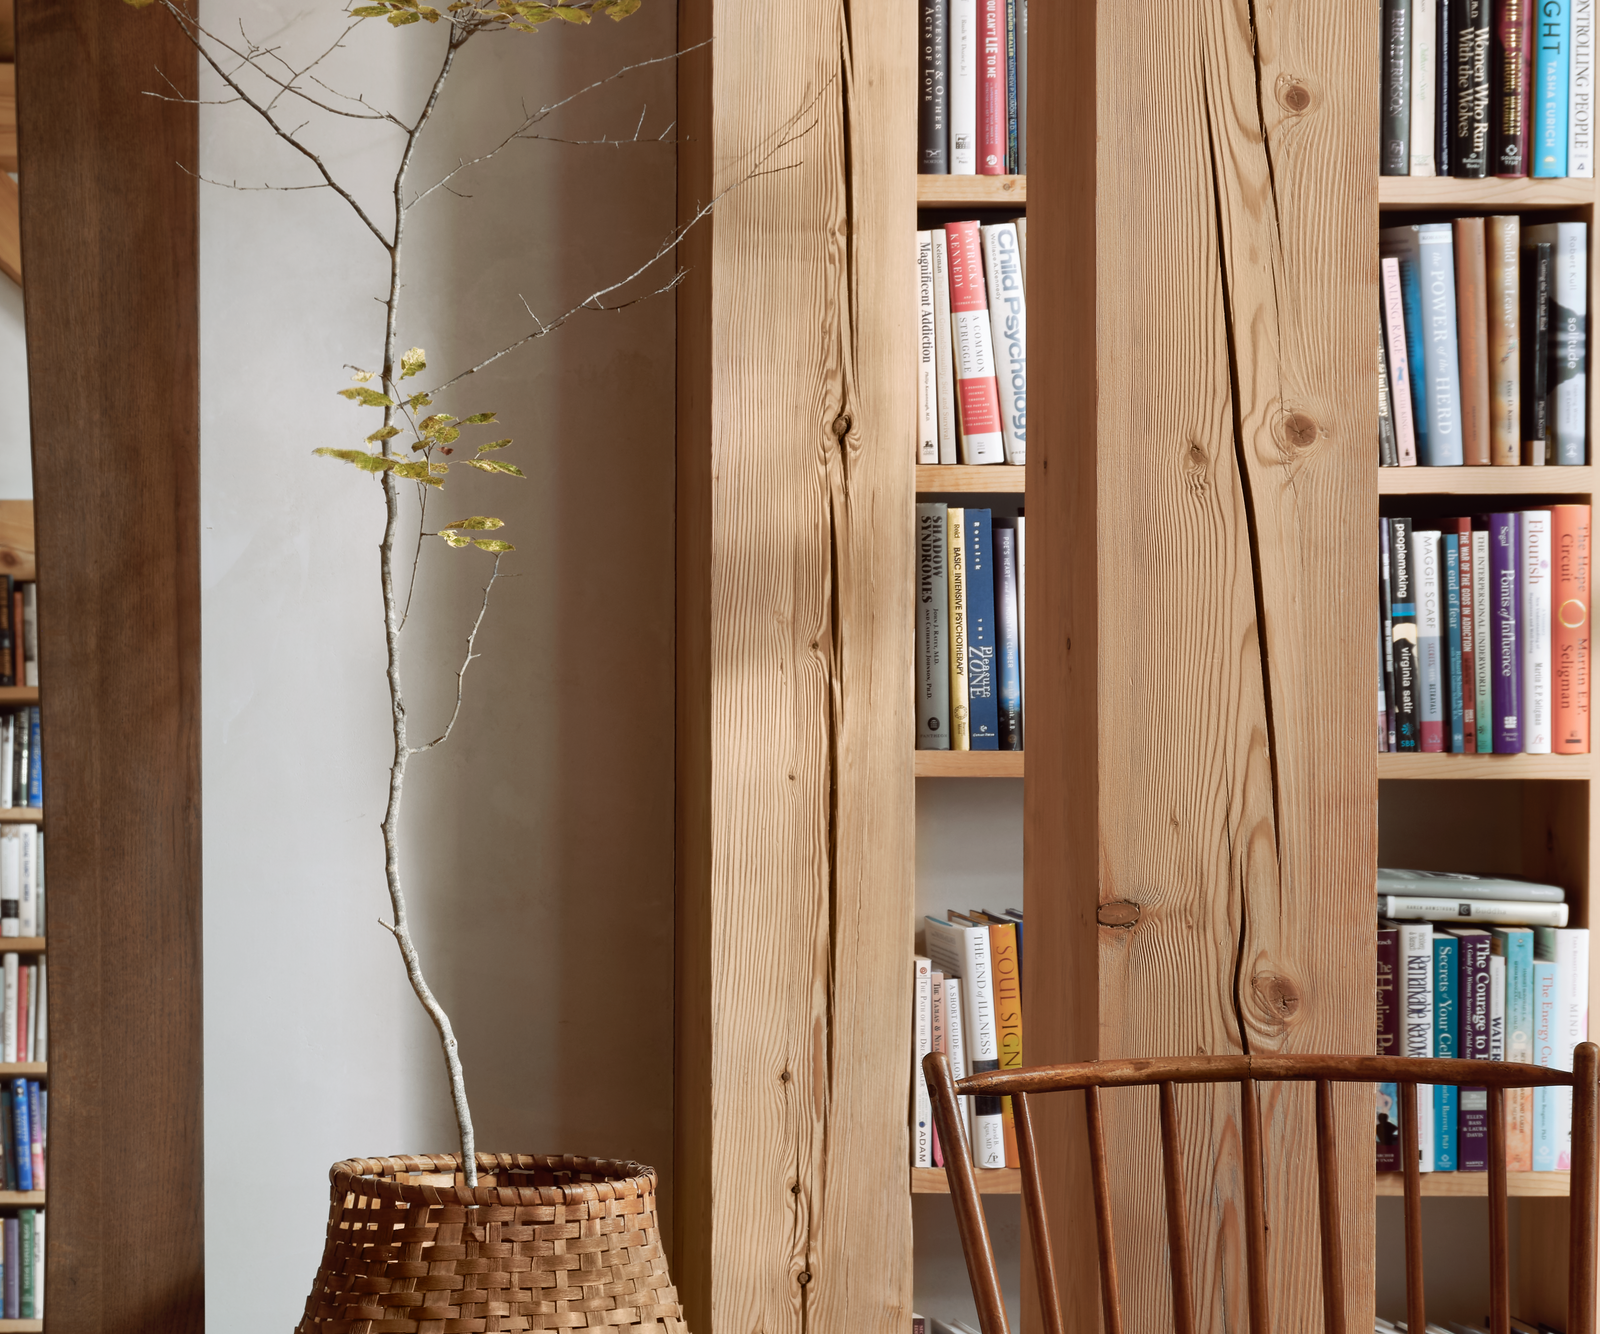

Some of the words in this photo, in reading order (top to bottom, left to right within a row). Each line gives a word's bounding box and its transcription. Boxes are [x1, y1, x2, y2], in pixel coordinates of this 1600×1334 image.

[925, 7, 933, 39] ACTS
[986, 12, 996, 35] CAN'T
[1505, 26, 1522, 49] THE
[926, 44, 932, 61] OF
[985, 37, 998, 54] LIE
[987, 56, 996, 66] TO
[1458, 27, 1474, 63] With
[1475, 26, 1490, 82] Women
[925, 69, 935, 102] LOVE
[935, 70, 944, 80] &
[987, 67, 996, 79] ME
[1458, 65, 1473, 87] the
[1504, 51, 1522, 93] STRONG
[1545, 61, 1557, 105] TASHA
[935, 85, 945, 131] OTHER
[1458, 91, 1472, 137] Wolves
[1474, 83, 1490, 121] Who
[1502, 95, 1522, 135] WOMAN
[1574, 92, 1589, 149] PEOPLE
[1473, 123, 1488, 152] Run
[1545, 107, 1556, 147] EURICH
[950, 233, 963, 289] KENNEDY
[964, 229, 978, 280] PATRICK
[997, 229, 1019, 291] Child
[1431, 251, 1440, 267] the
[1504, 223, 1515, 266] Should
[1568, 235, 1578, 268] Robert
[918, 242, 932, 307] Magnificent
[969, 282, 979, 291] J.
[1386, 264, 1400, 321] HEALING
[1503, 267, 1515, 287] You
[1568, 270, 1577, 292] Kull
[1430, 269, 1449, 344] POWER
[1503, 289, 1515, 329] Leave?
[921, 309, 934, 364] Addiction
[959, 317, 972, 373] STRUGGLE
[973, 325, 985, 373] COMMON
[1391, 323, 1405, 356] RAGE
[1436, 345, 1447, 357] of
[1567, 317, 1579, 369] solitude
[1004, 297, 1026, 442] Psychology
[1438, 359, 1449, 374] the
[1435, 377, 1453, 436] HERD
[932, 516, 943, 578] SHADOW
[1460, 531, 1468, 544] THE
[1460, 546, 1469, 561] WAR
[1477, 535, 1485, 554] THE
[1499, 526, 1509, 547] Segal
[1529, 520, 1544, 584] Flourish
[1578, 526, 1589, 551] The
[921, 515, 933, 603] SYNDROMES
[953, 548, 962, 571] BASIC
[1394, 523, 1408, 598] peoplemaking
[1423, 536, 1435, 588] MAGGIE
[1461, 562, 1469, 571] OF
[1561, 533, 1574, 583] Circuit
[1576, 553, 1587, 592] Hope
[954, 571, 963, 610] INTENSIVE
[1448, 570, 1456, 591] end
[1461, 573, 1470, 586] THE
[1462, 588, 1470, 605] GODS
[1478, 556, 1486, 630] INTERPERSONAL
[1501, 569, 1515, 605] Points
[1425, 592, 1436, 629] SCARF
[1450, 594, 1457, 605] of
[1462, 607, 1471, 615] IN
[1501, 607, 1510, 619] of
[955, 612, 964, 676] PSYCHOTHERAPY
[1463, 616, 1472, 652] ADDICTION
[1502, 619, 1516, 677] Influence
[969, 646, 982, 700] ZONE
[979, 646, 993, 698] Pleasure
[1401, 647, 1411, 689] virginia
[1478, 632, 1487, 697] UNDERWORLD
[1557, 644, 1574, 710] Seligman
[1402, 690, 1414, 714] satir
[974, 933, 984, 960] THE
[1476, 940, 1490, 971] The
[975, 963, 987, 989] END
[996, 945, 1016, 1006] SOUL
[1542, 974, 1555, 998] The
[1472, 973, 1490, 1031] Courage
[978, 1000, 991, 1055] ILLNESS
[1538, 1001, 1553, 1042] Energy
[1476, 1035, 1488, 1049] to
